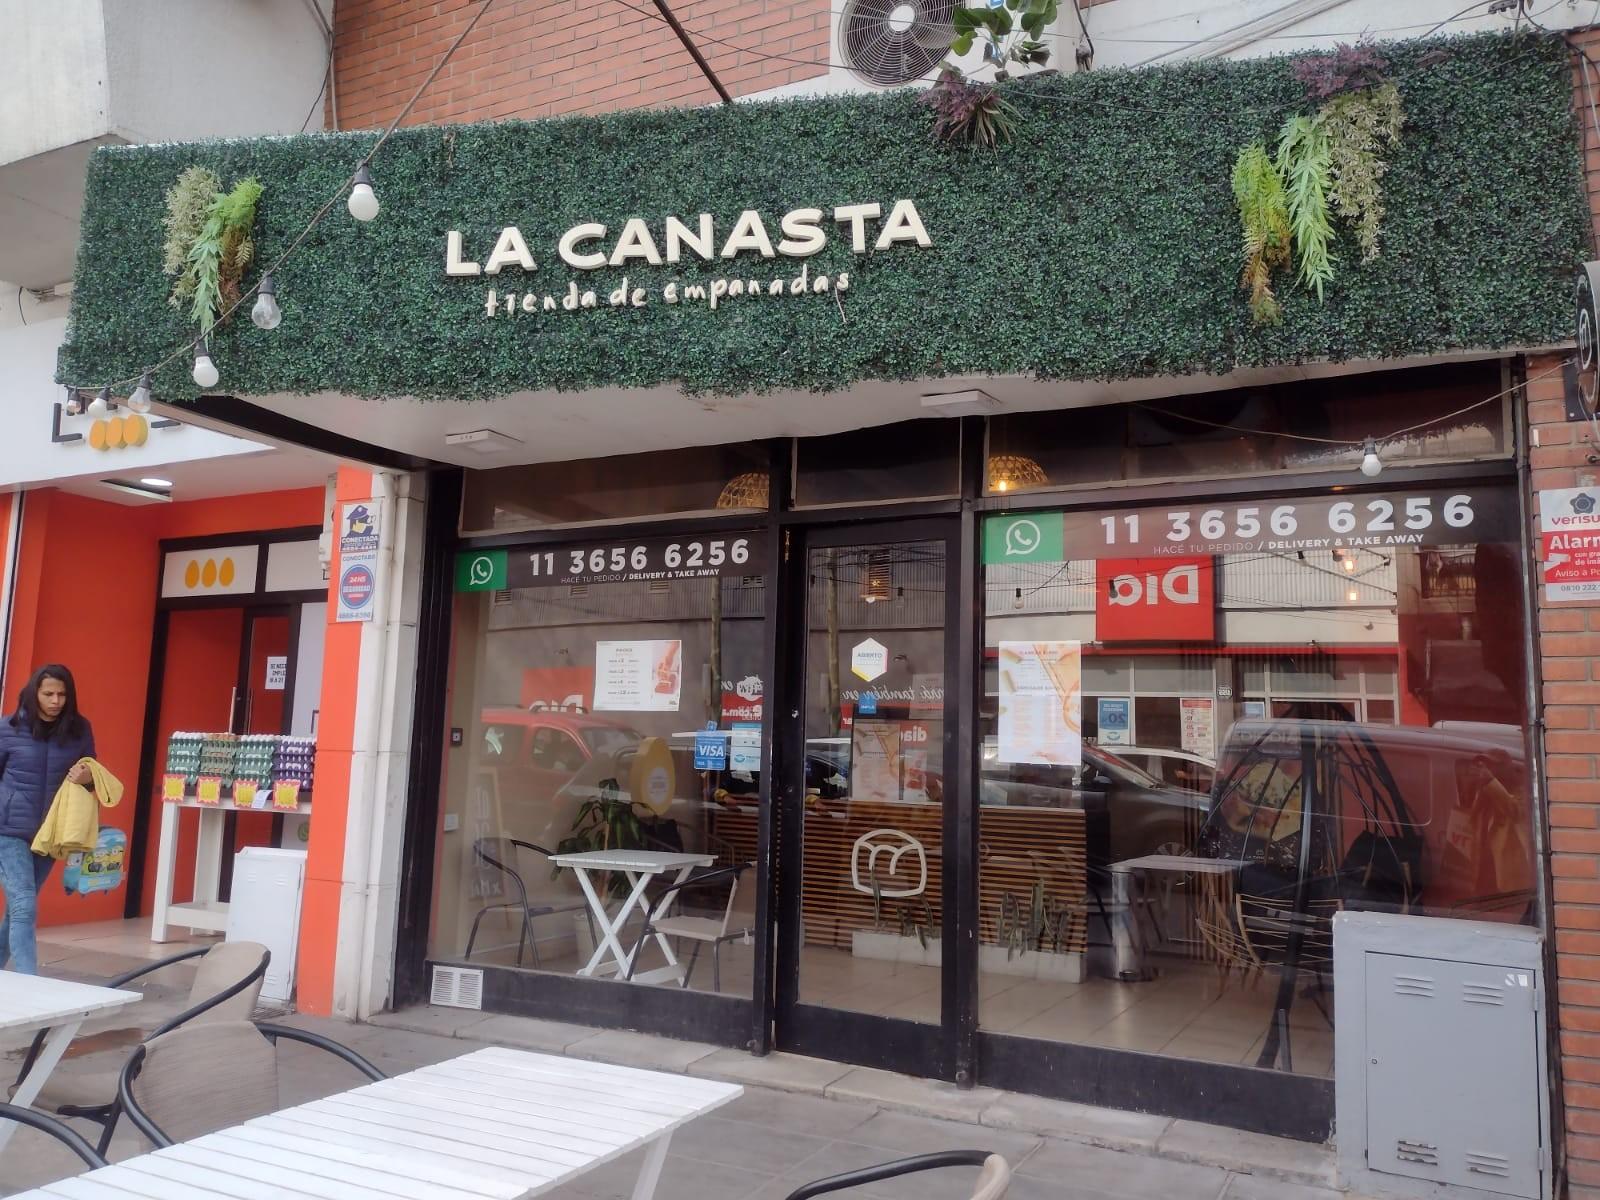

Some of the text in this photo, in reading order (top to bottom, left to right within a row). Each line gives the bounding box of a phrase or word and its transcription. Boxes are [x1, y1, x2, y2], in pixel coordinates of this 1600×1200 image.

[446, 199, 932, 276] LA CANASTA
[484, 264, 849, 316] tienda de empanadas
[1100, 494, 1474, 545] 11 3656 6256
[530, 539, 749, 576] 11 3656 6256
[1190, 543, 1204, 554] TU
[1208, 541, 1253, 553] PEDIDO
[1257, 540, 1264, 550] /
[1268, 538, 1331, 549] DELIVERY
[1335, 537, 1342, 546] &
[1347, 536, 1381, 546] TAKE
[1385, 534, 1424, 544] AWAY
[583, 575, 591, 583] TU
[594, 574, 621, 582] PEDIDO
[629, 571, 665, 580] DELIVERY
[675, 570, 695, 578] TAKE
[697, 568, 719, 576] AWAY
[1555, 569, 1579, 577] Aviso
[699, 745, 724, 757] VISA
